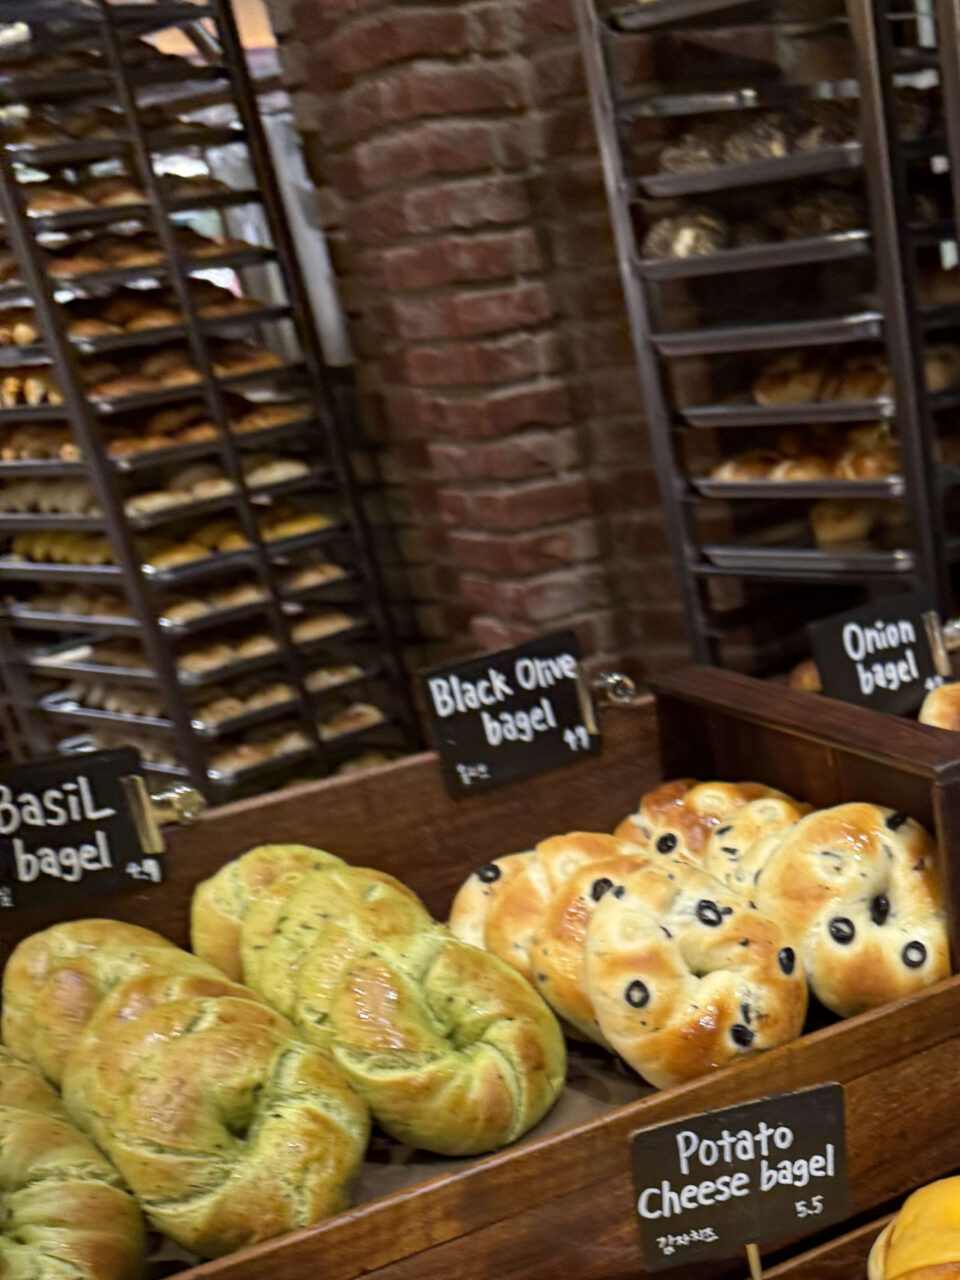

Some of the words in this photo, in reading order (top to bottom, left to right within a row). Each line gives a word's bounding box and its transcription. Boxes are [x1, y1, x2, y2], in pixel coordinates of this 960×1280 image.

[842, 620, 917, 662] Onion
[428, 668, 515, 718] Black
[515, 652, 579, 691] Olive
[856, 648, 919, 695] bagel
[481, 698, 558, 747] bagel
[12, 830, 112, 882] bagel
[676, 1121, 794, 1175] Potato
[637, 1172, 751, 1219] Cheese
[759, 1143, 835, 1192] bagel
